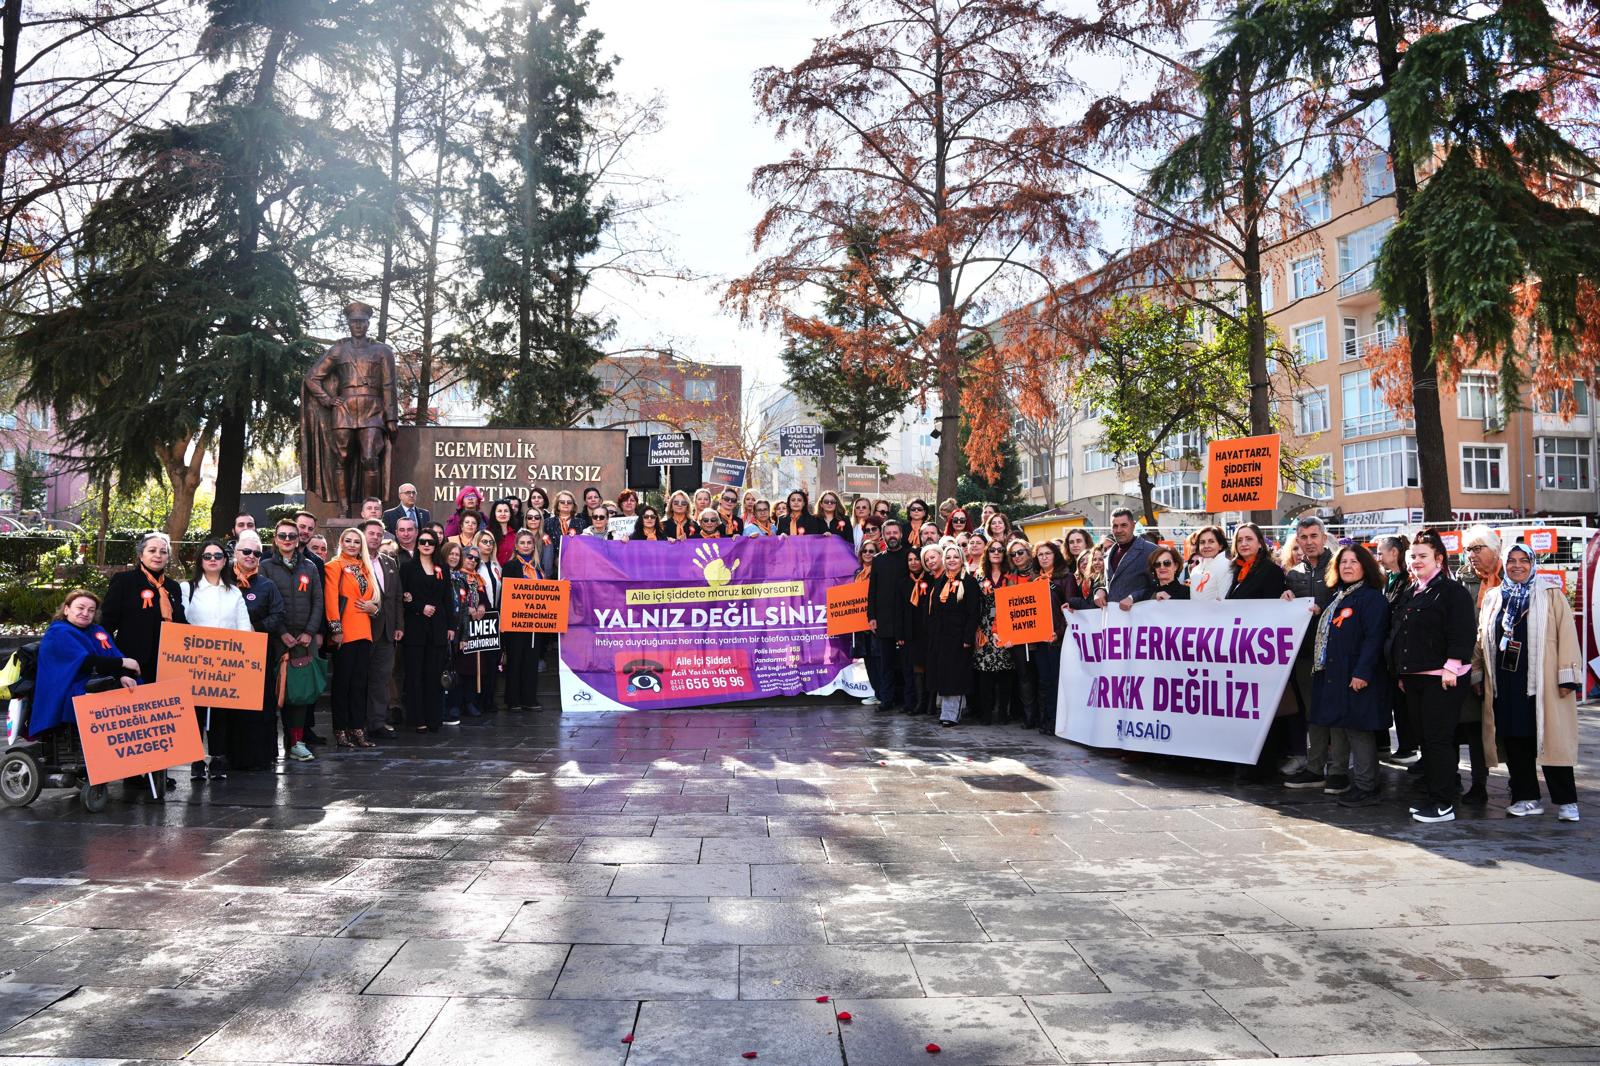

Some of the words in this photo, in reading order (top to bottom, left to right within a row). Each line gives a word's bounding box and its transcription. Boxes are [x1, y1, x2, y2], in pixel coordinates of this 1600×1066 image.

[781, 424, 823, 436] ŞİDDETİN
[435, 439, 536, 458] EGEMENLİK
[651, 448, 690, 456] İNSANLIĞA
[658, 441, 684, 449] ŞİDDET
[651, 456, 690, 464] İHANETTİR
[1216, 450, 1244, 461] HAYAT
[1245, 447, 1272, 458] TARZI,
[434, 464, 517, 480] KAYITSIZ
[528, 465, 602, 482] ŞARTSIZ
[1224, 460, 1262, 477] ŞİDDETİN
[1221, 474, 1263, 489] BAHANESİ
[434, 481, 548, 502] MİETİND
[1222, 492, 1260, 502] OLAMAZ.
[514, 583, 560, 592] VARLIĞIMIZA
[631, 592, 650, 601] Aile
[653, 590, 664, 602] içi
[666, 590, 706, 602] şiddete
[708, 588, 739, 598] maruz
[742, 585, 800, 597] kalıyorsanız
[1008, 594, 1036, 607] FİZİKSEL
[512, 610, 558, 620] DİRENCİMİZE
[594, 608, 686, 628] YALNIZ
[692, 600, 827, 628] DEĞİLSİNİZ
[830, 608, 860, 618] YOLLARINI
[1010, 608, 1037, 621] ŞİDDETE
[470, 618, 497, 637] LMEK
[1012, 620, 1036, 631] HAYIR!
[184, 634, 245, 655] ŞİDDETİN,
[466, 637, 498, 650] TEMİYORUM
[595, 638, 624, 648] İhtiyaç
[626, 638, 677, 648] duyduğunuz
[694, 638, 718, 646] anda,
[718, 636, 748, 646] yardım
[761, 634, 790, 643] telefon
[1134, 618, 1294, 666] ERKEKLİKSE
[676, 656, 692, 666] Aile
[694, 655, 704, 668] İçi
[706, 656, 732, 668] Şiddet
[686, 678, 710, 690] 656
[712, 676, 728, 688] 96
[729, 676, 744, 687] 96
[191, 685, 240, 698] LAMAZ.
[1152, 668, 1260, 720] DEĞİLİZ!
[89, 704, 131, 720] “BÜTÜN
[132, 696, 181, 713] ERKEKLER
[90, 721, 118, 734] ÖYLE
[118, 715, 148, 729] DEĞİL
[1124, 720, 1172, 740] ASAİD
[107, 723, 176, 746] DEMEKTEN
[115, 737, 174, 758] VAZGEÇ!
